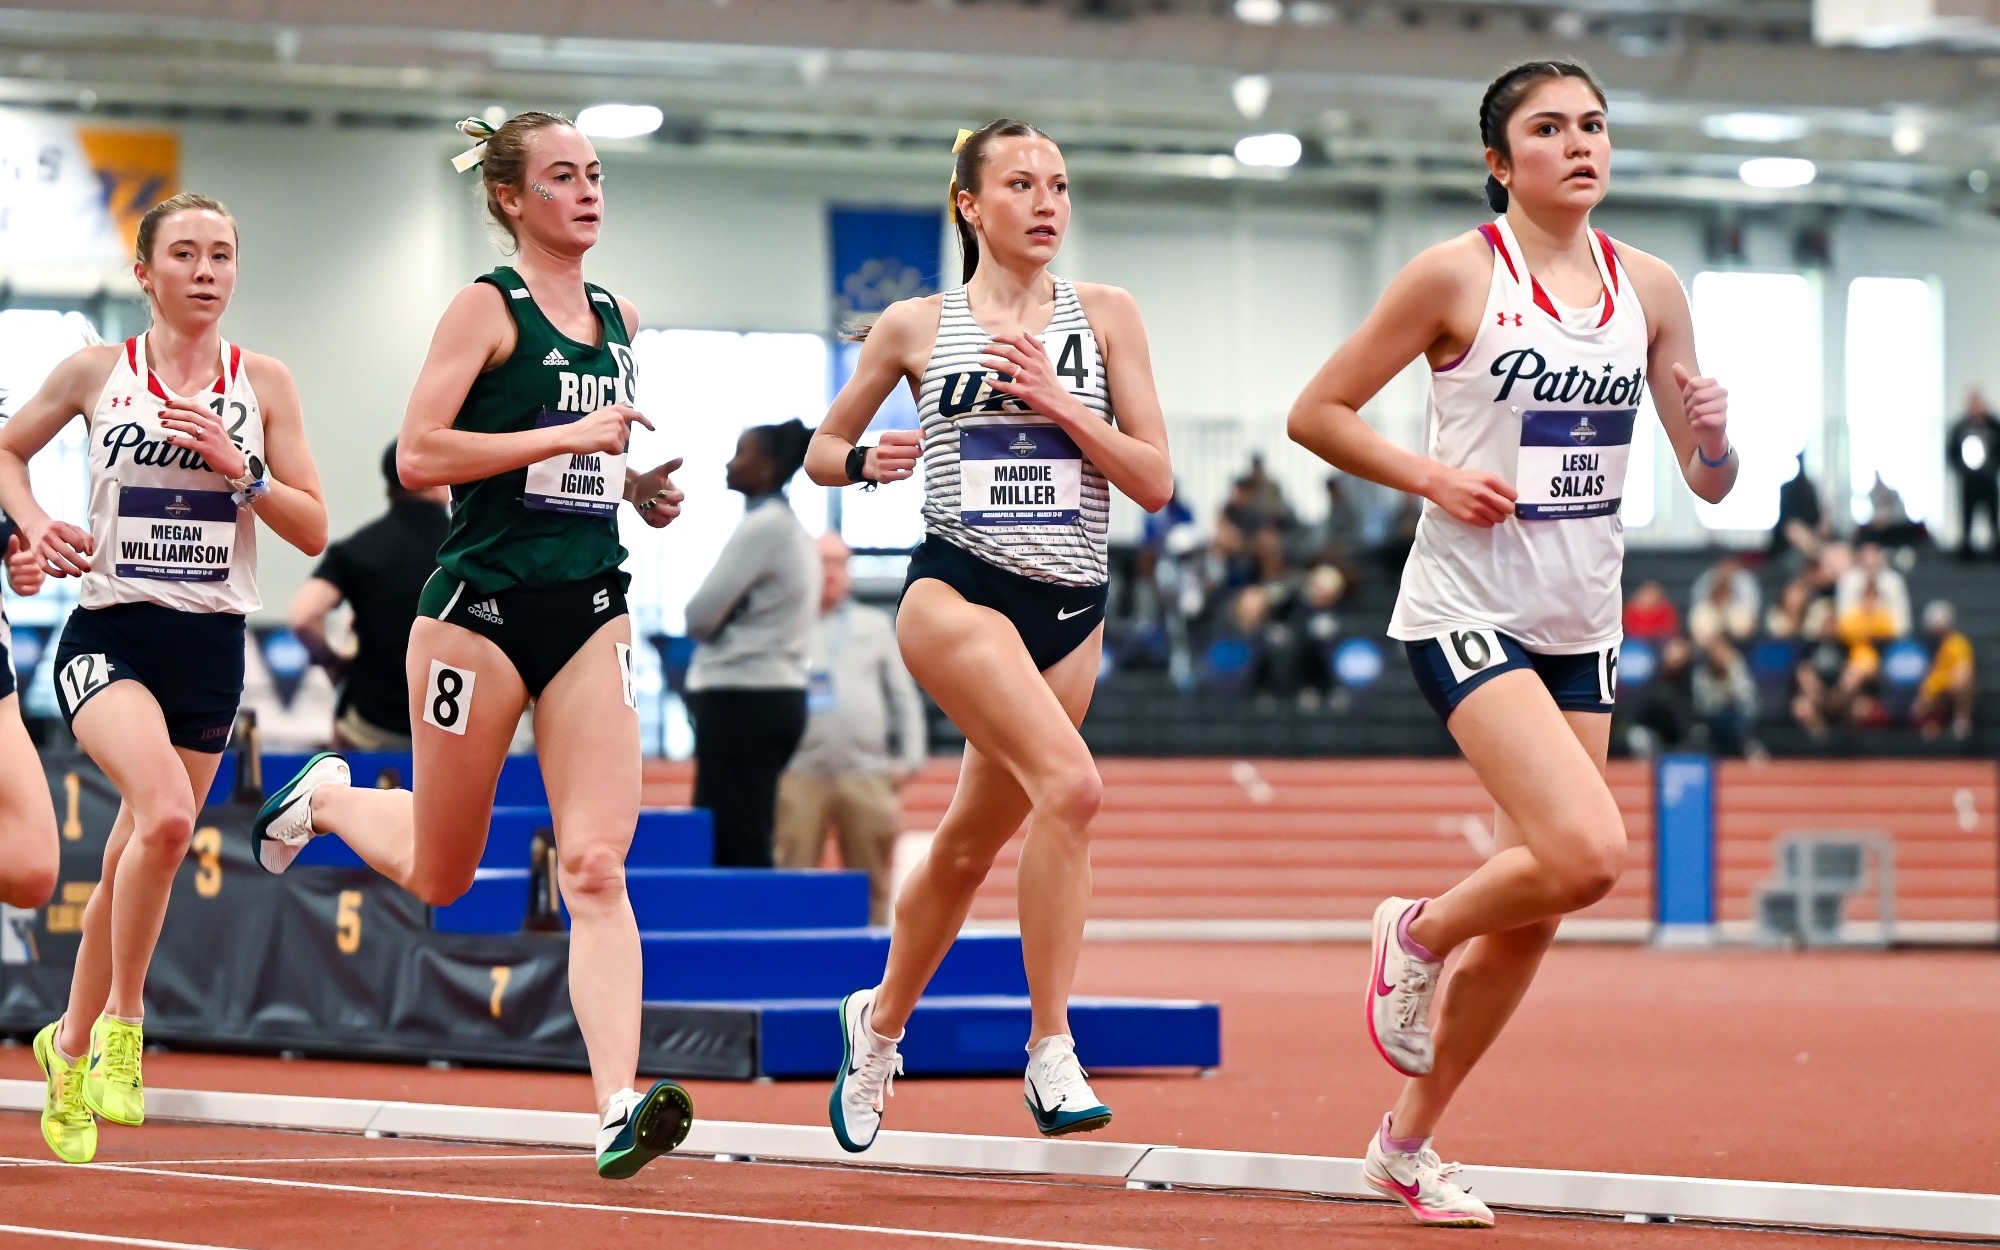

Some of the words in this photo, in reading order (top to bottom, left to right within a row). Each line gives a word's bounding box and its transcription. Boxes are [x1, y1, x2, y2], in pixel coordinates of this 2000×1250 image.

[542, 358, 570, 366] adidas
[617, 347, 636, 404] 8
[1056, 333, 1089, 389] 4
[1490, 347, 1646, 407] Patriot
[557, 371, 620, 413] ROC
[569, 454, 601, 473] ANNA
[994, 465, 1052, 482] MADDIE
[1562, 453, 1599, 472] LESLI
[560, 473, 605, 497] IGIMS
[990, 485, 1056, 505] MILLER
[1549, 474, 1605, 498] SALAS
[150, 524, 202, 542] MEGAN
[121, 541, 229, 564] WILLIAMSON
[467, 605, 504, 625] adidas
[592, 588, 610, 614] S
[1450, 630, 1491, 671] 6
[66, 654, 100, 701] 12
[432, 668, 463, 728] 8
[63, 772, 84, 842] 1
[192, 827, 223, 898] 3
[336, 890, 363, 956] 5
[489, 966, 512, 1019] 7
